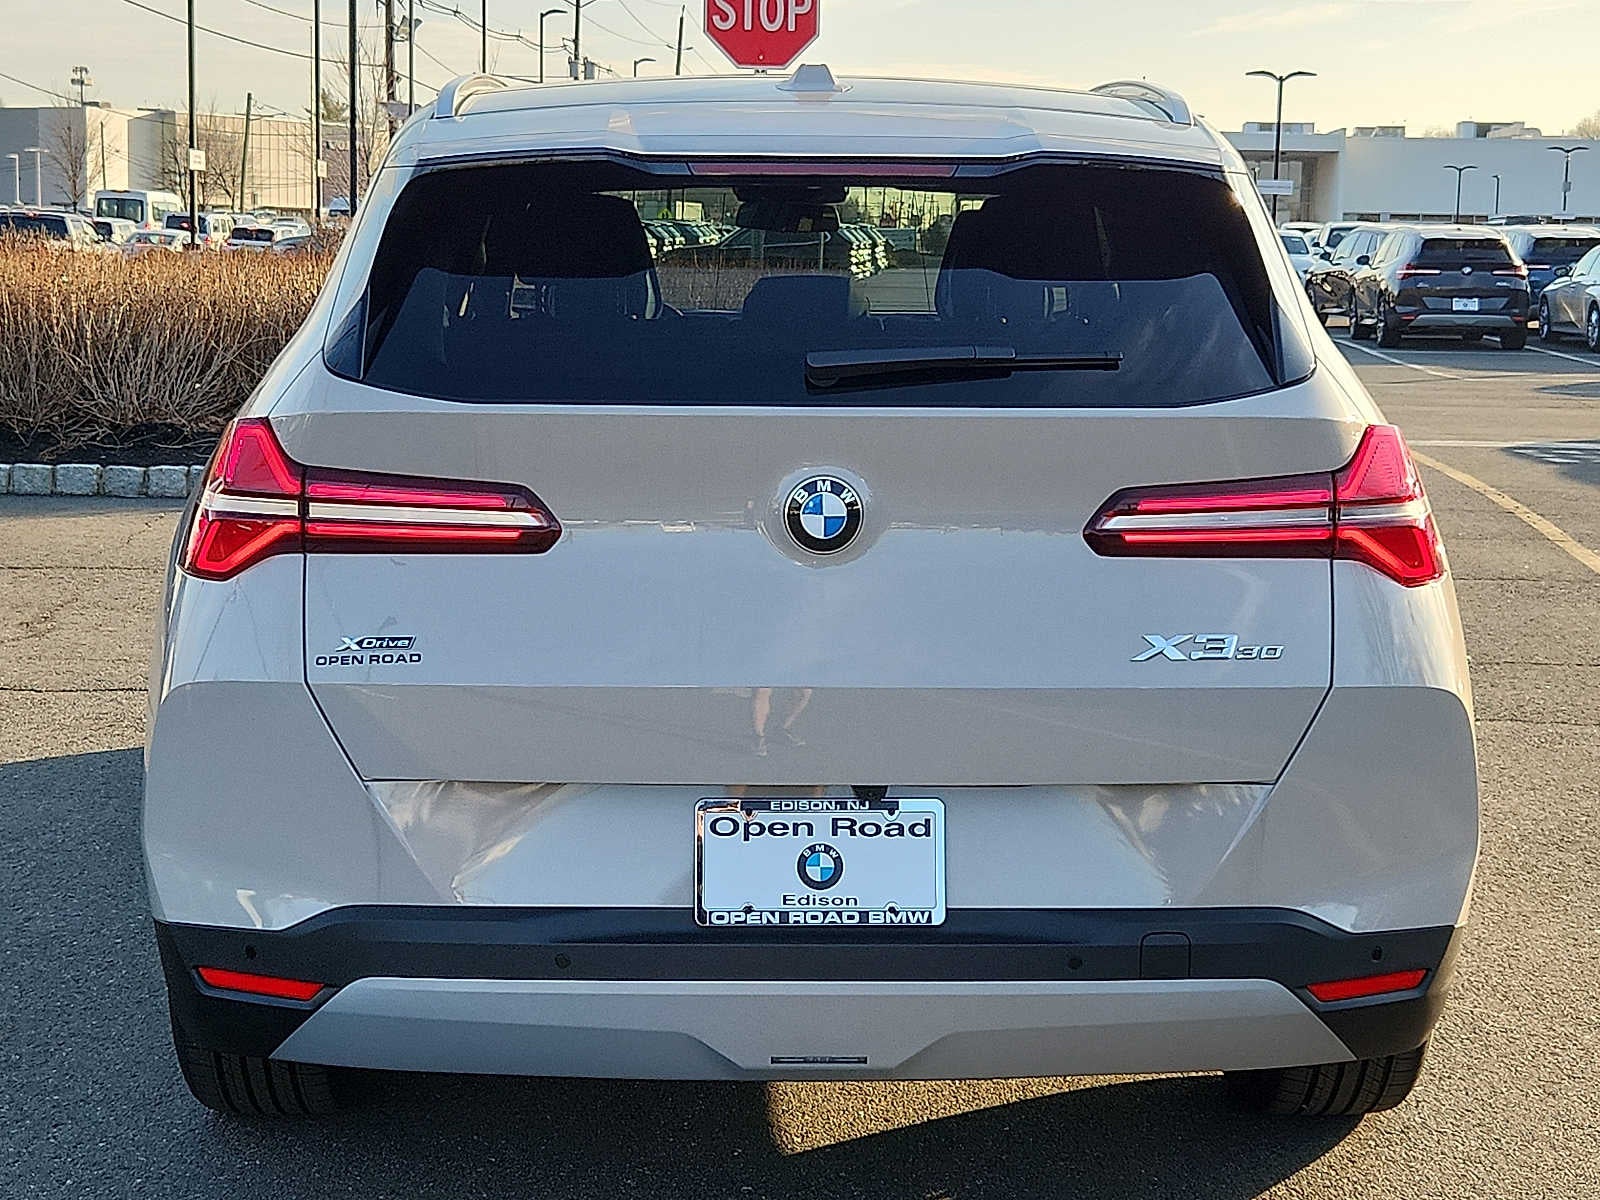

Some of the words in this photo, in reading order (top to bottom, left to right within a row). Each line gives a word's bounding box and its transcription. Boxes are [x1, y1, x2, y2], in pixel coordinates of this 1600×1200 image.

[712, 0, 814, 32] STOP
[793, 480, 856, 504] BMW
[315, 654, 364, 666] OPEN
[369, 653, 422, 665] ROAD
[770, 800, 841, 811] EDISON,
[848, 800, 870, 811] NJ
[709, 816, 814, 841] Open
[831, 817, 931, 838] Road
[803, 844, 838, 858] BMW
[782, 894, 858, 906] Edison
[710, 911, 780, 924] OPEN
[788, 911, 860, 924] ROAD
[868, 911, 930, 924] BMW
